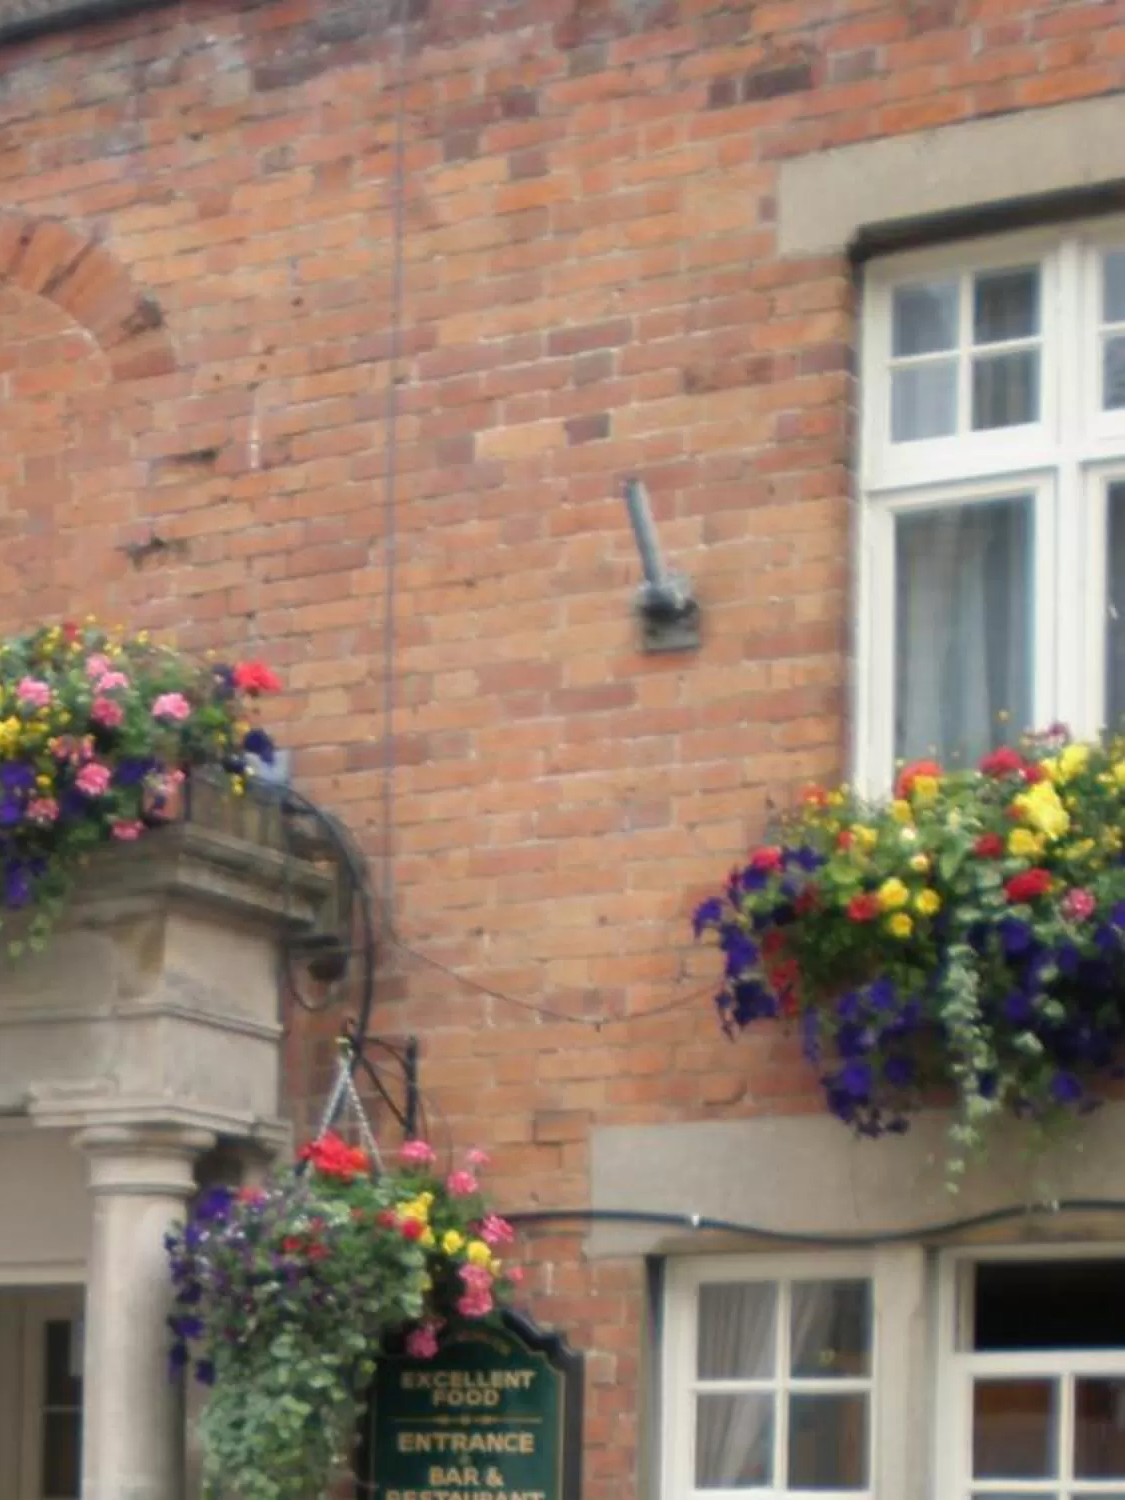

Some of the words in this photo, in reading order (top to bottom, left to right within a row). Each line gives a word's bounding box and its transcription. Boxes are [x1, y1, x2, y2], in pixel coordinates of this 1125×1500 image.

[401, 1369, 537, 1391] EXCELLENT
[432, 1388, 500, 1408] FOOD
[397, 1431, 535, 1454] ENTRANCE
[428, 1466, 481, 1487] BAR
[485, 1467, 504, 1487] &
